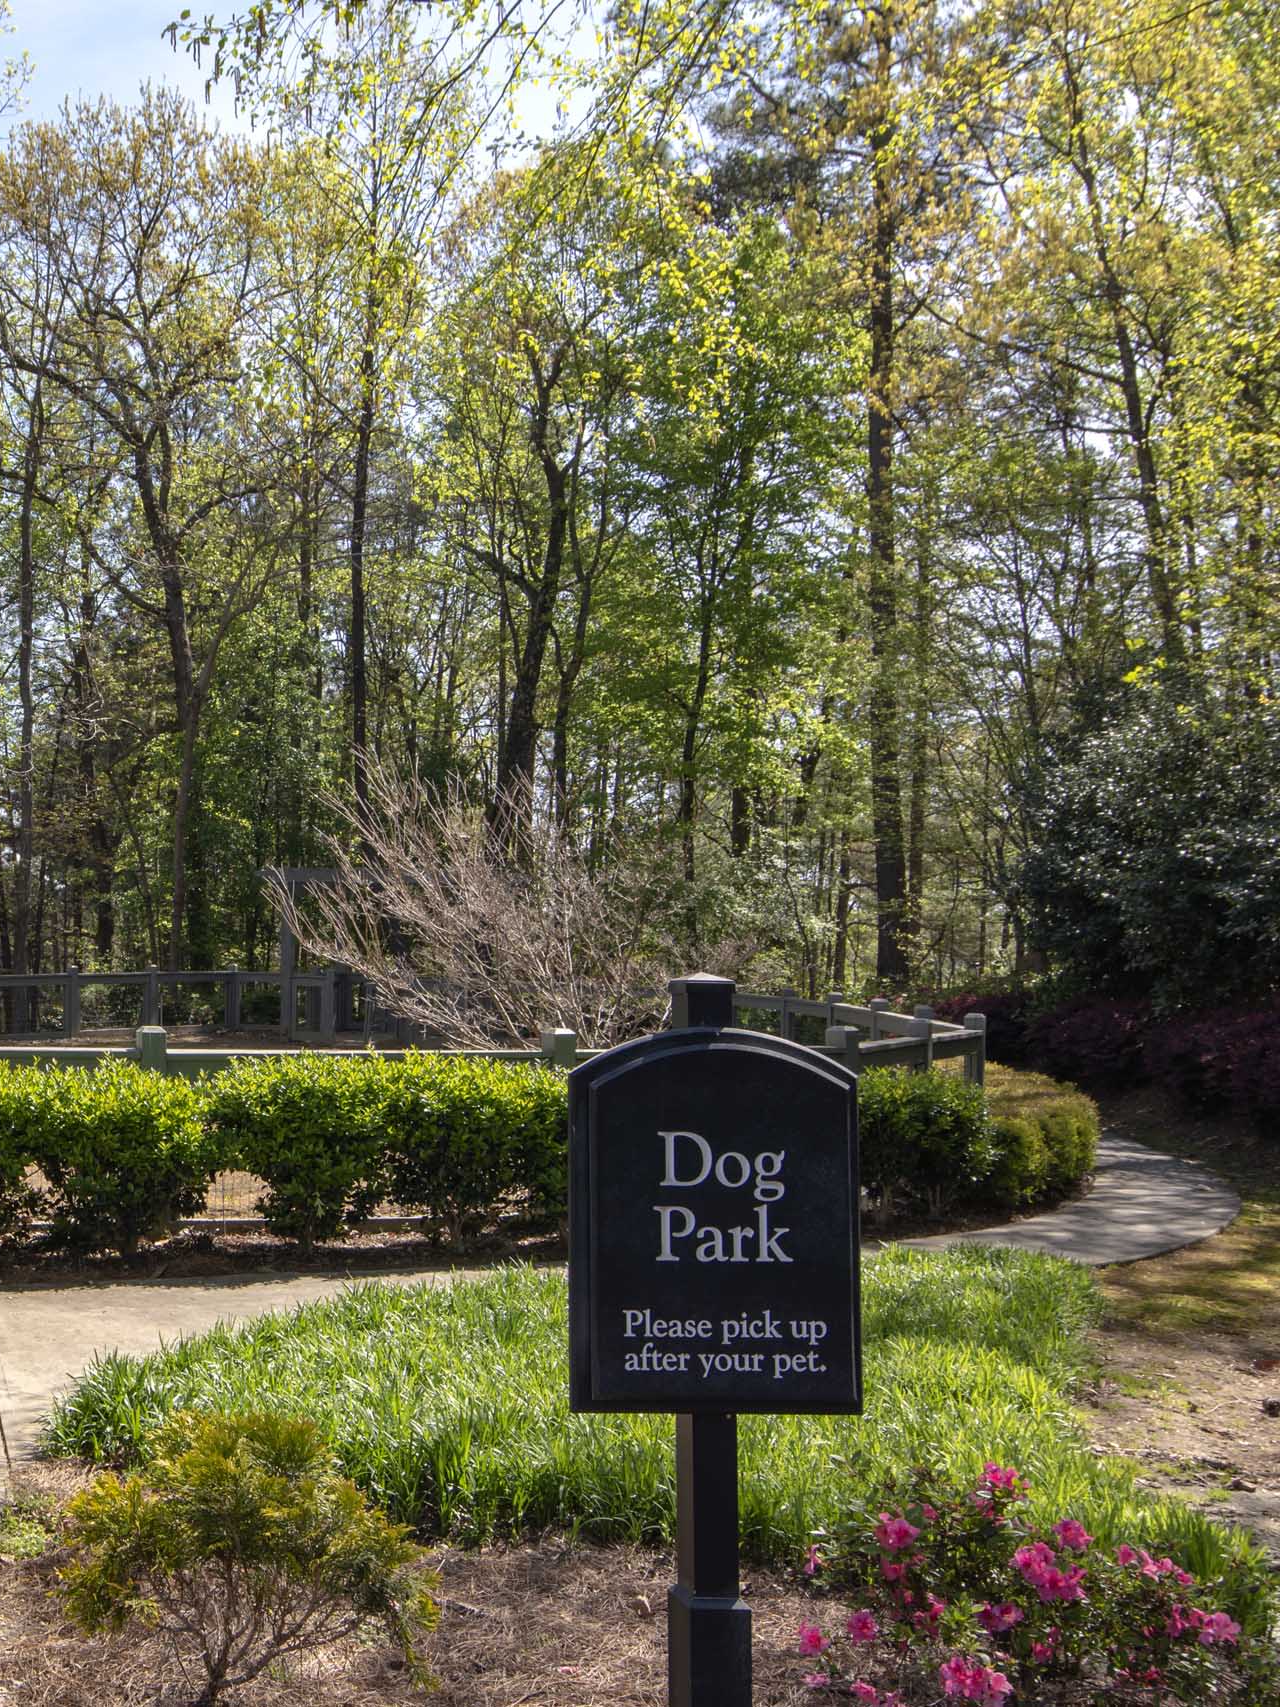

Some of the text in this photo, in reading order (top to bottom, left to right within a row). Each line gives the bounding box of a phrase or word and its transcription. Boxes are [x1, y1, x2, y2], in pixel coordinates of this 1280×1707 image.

[657, 1131, 785, 1202] Dog
[652, 1204, 794, 1263] Park
[623, 1308, 828, 1346] Please pick up
[624, 1343, 828, 1379] after your pet.
